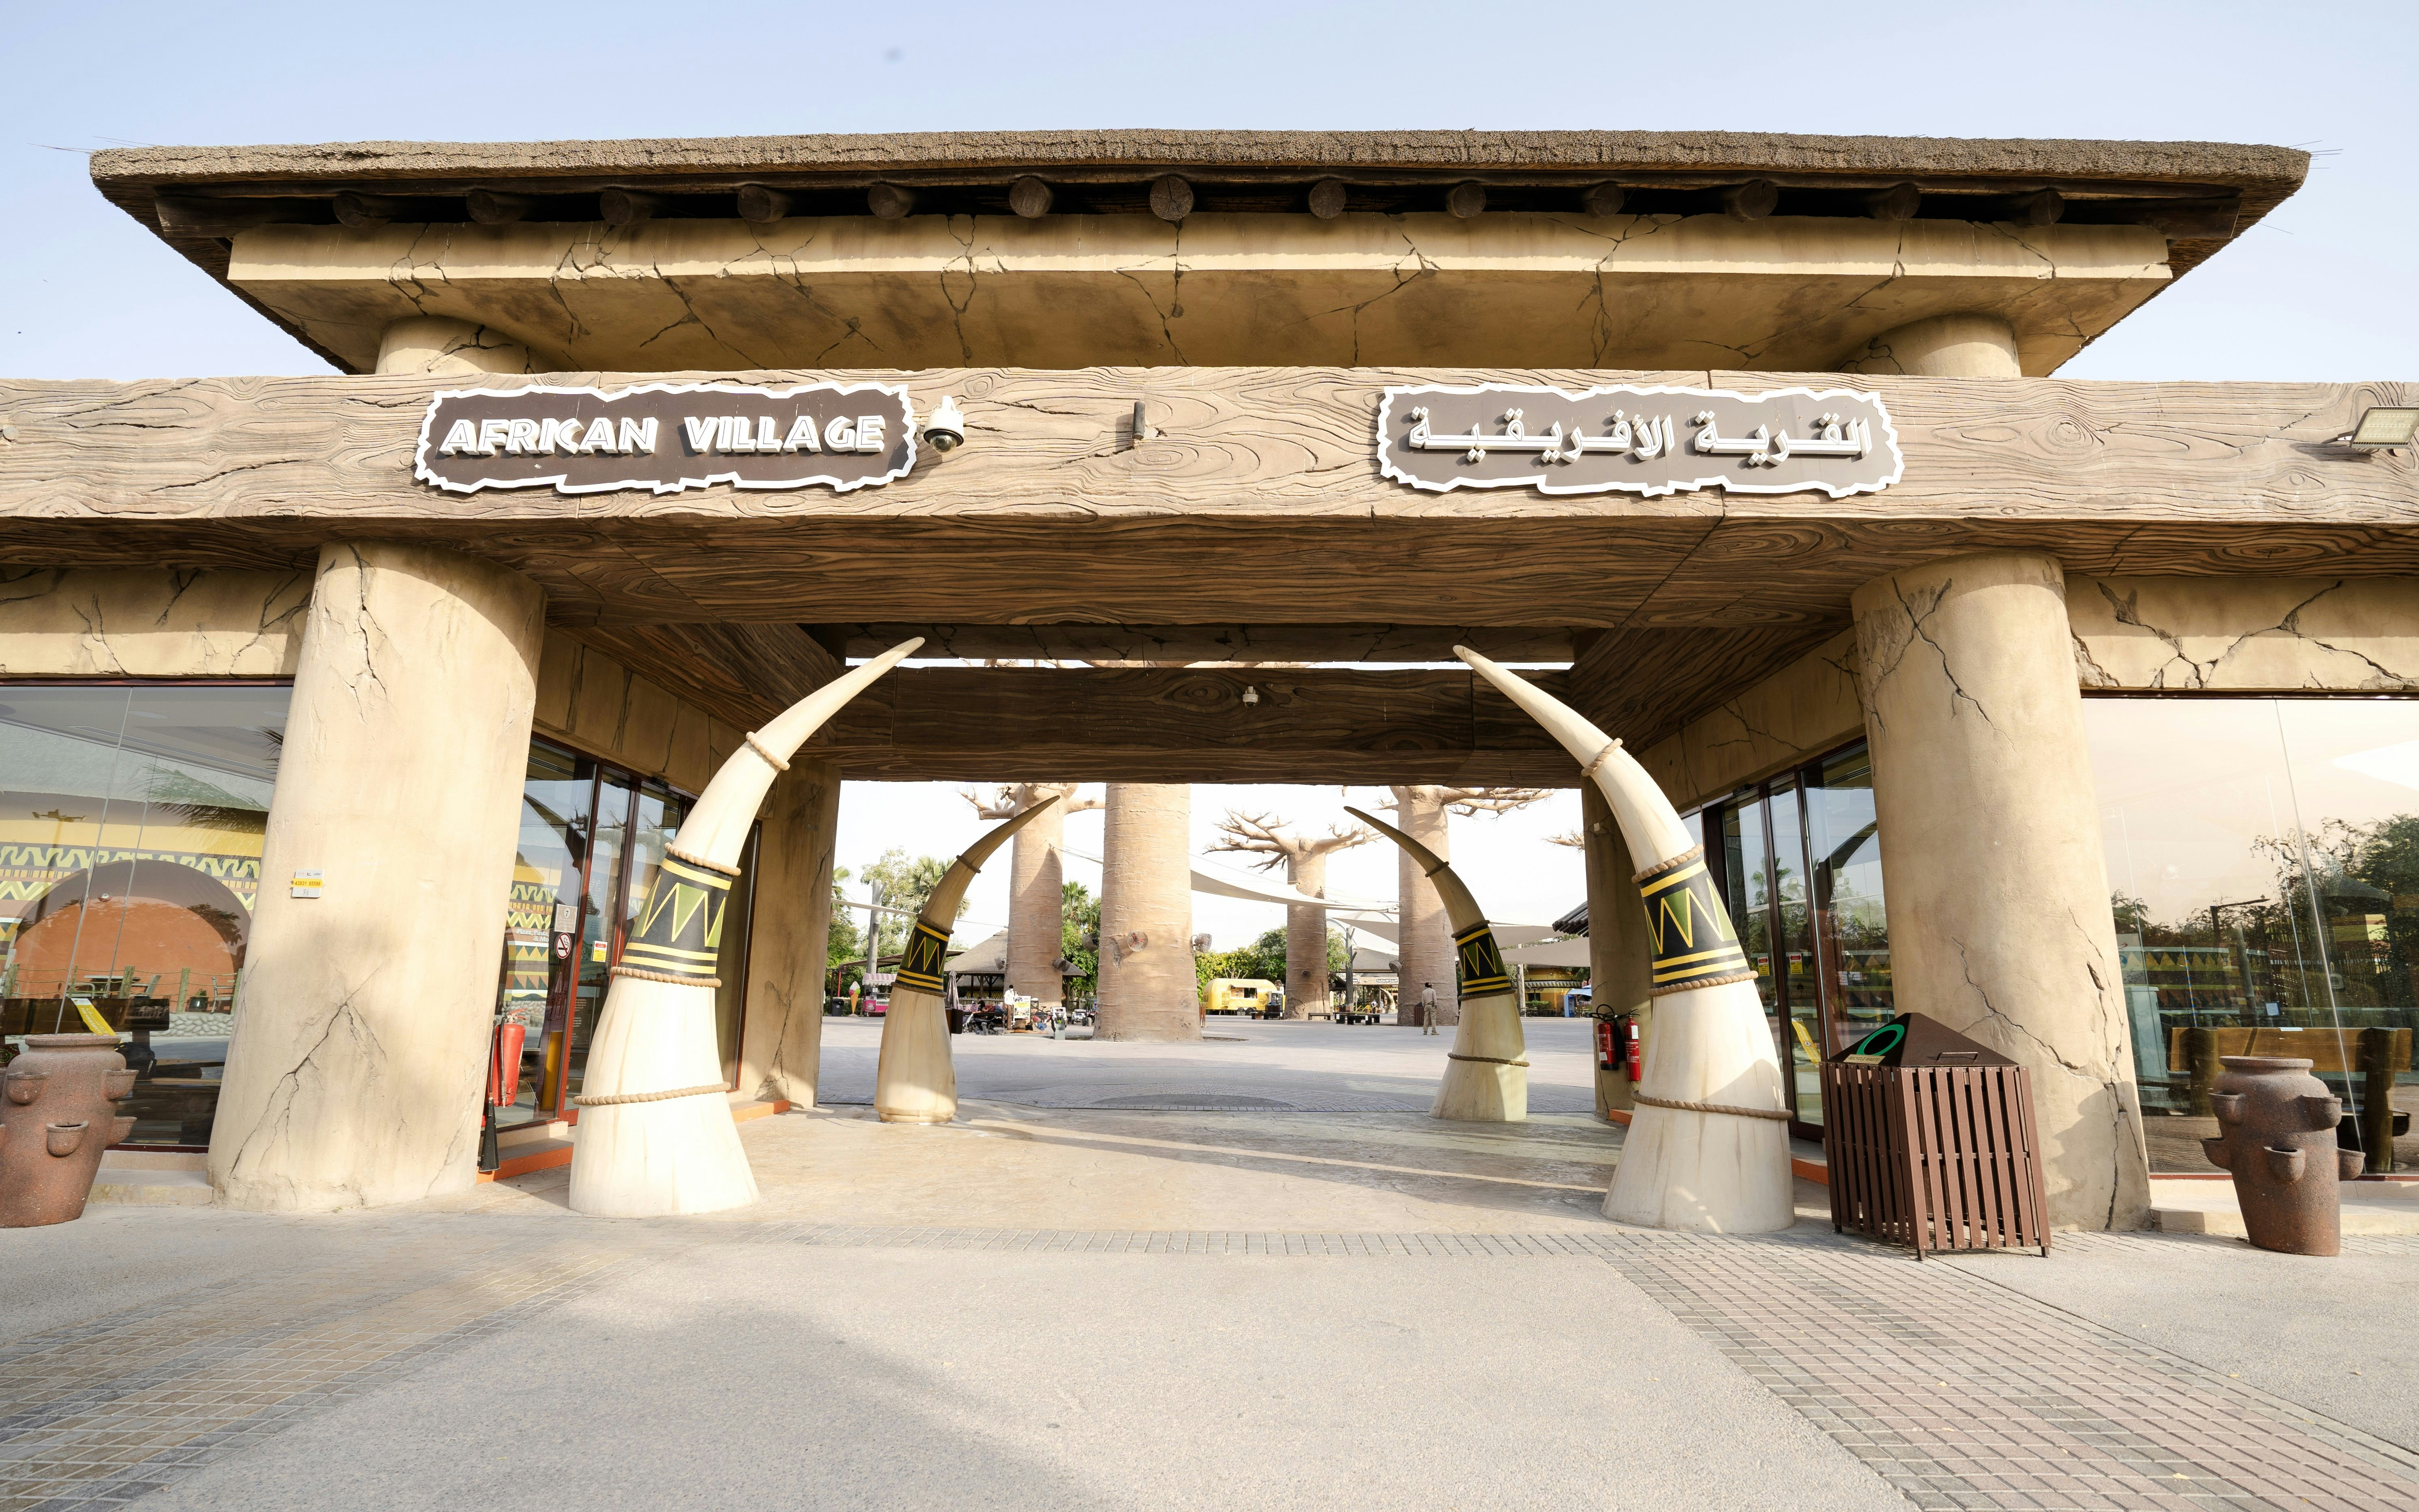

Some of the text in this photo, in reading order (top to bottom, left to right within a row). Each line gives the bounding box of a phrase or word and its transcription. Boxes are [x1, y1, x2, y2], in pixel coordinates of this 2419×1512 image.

[439, 415, 886, 455] AFRICAN VILLAGE
[1695, 410, 1873, 466] القرية
